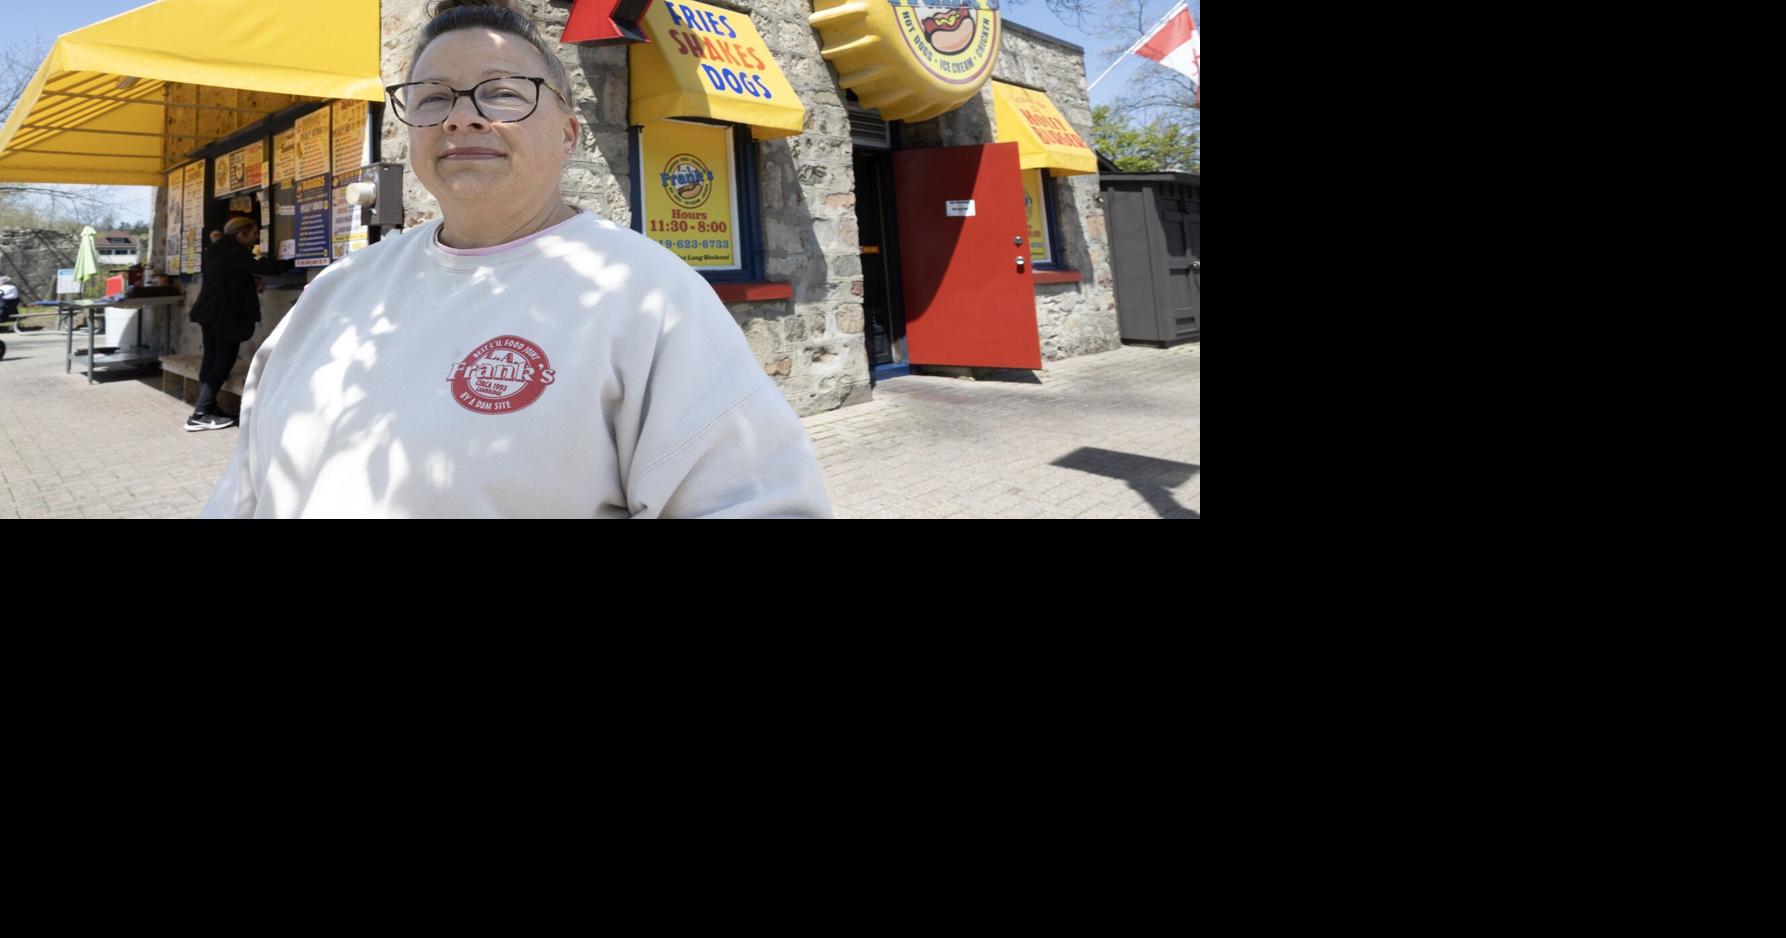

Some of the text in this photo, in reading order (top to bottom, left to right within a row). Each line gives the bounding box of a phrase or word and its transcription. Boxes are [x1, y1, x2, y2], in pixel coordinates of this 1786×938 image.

[664, 0, 737, 38] FRIES
[902, 11, 933, 62] HOT DOGS
[976, 17, 990, 57] CHICKEN
[668, 29, 765, 70] SHAKES
[940, 57, 975, 73] ICE CREAM
[701, 63, 772, 99] DOGS
[671, 209, 708, 220] Hours
[650, 220, 688, 232] 11:30
[697, 221, 727, 233] 8:00
[472, 345, 488, 359] BEST
[504, 339, 525, 350] FOOD
[523, 346, 540, 361] JOINT
[446, 362, 556, 385] Frank's
[475, 380, 492, 388] CIRCA
[460, 391, 512, 410] BY A DAM SITE
